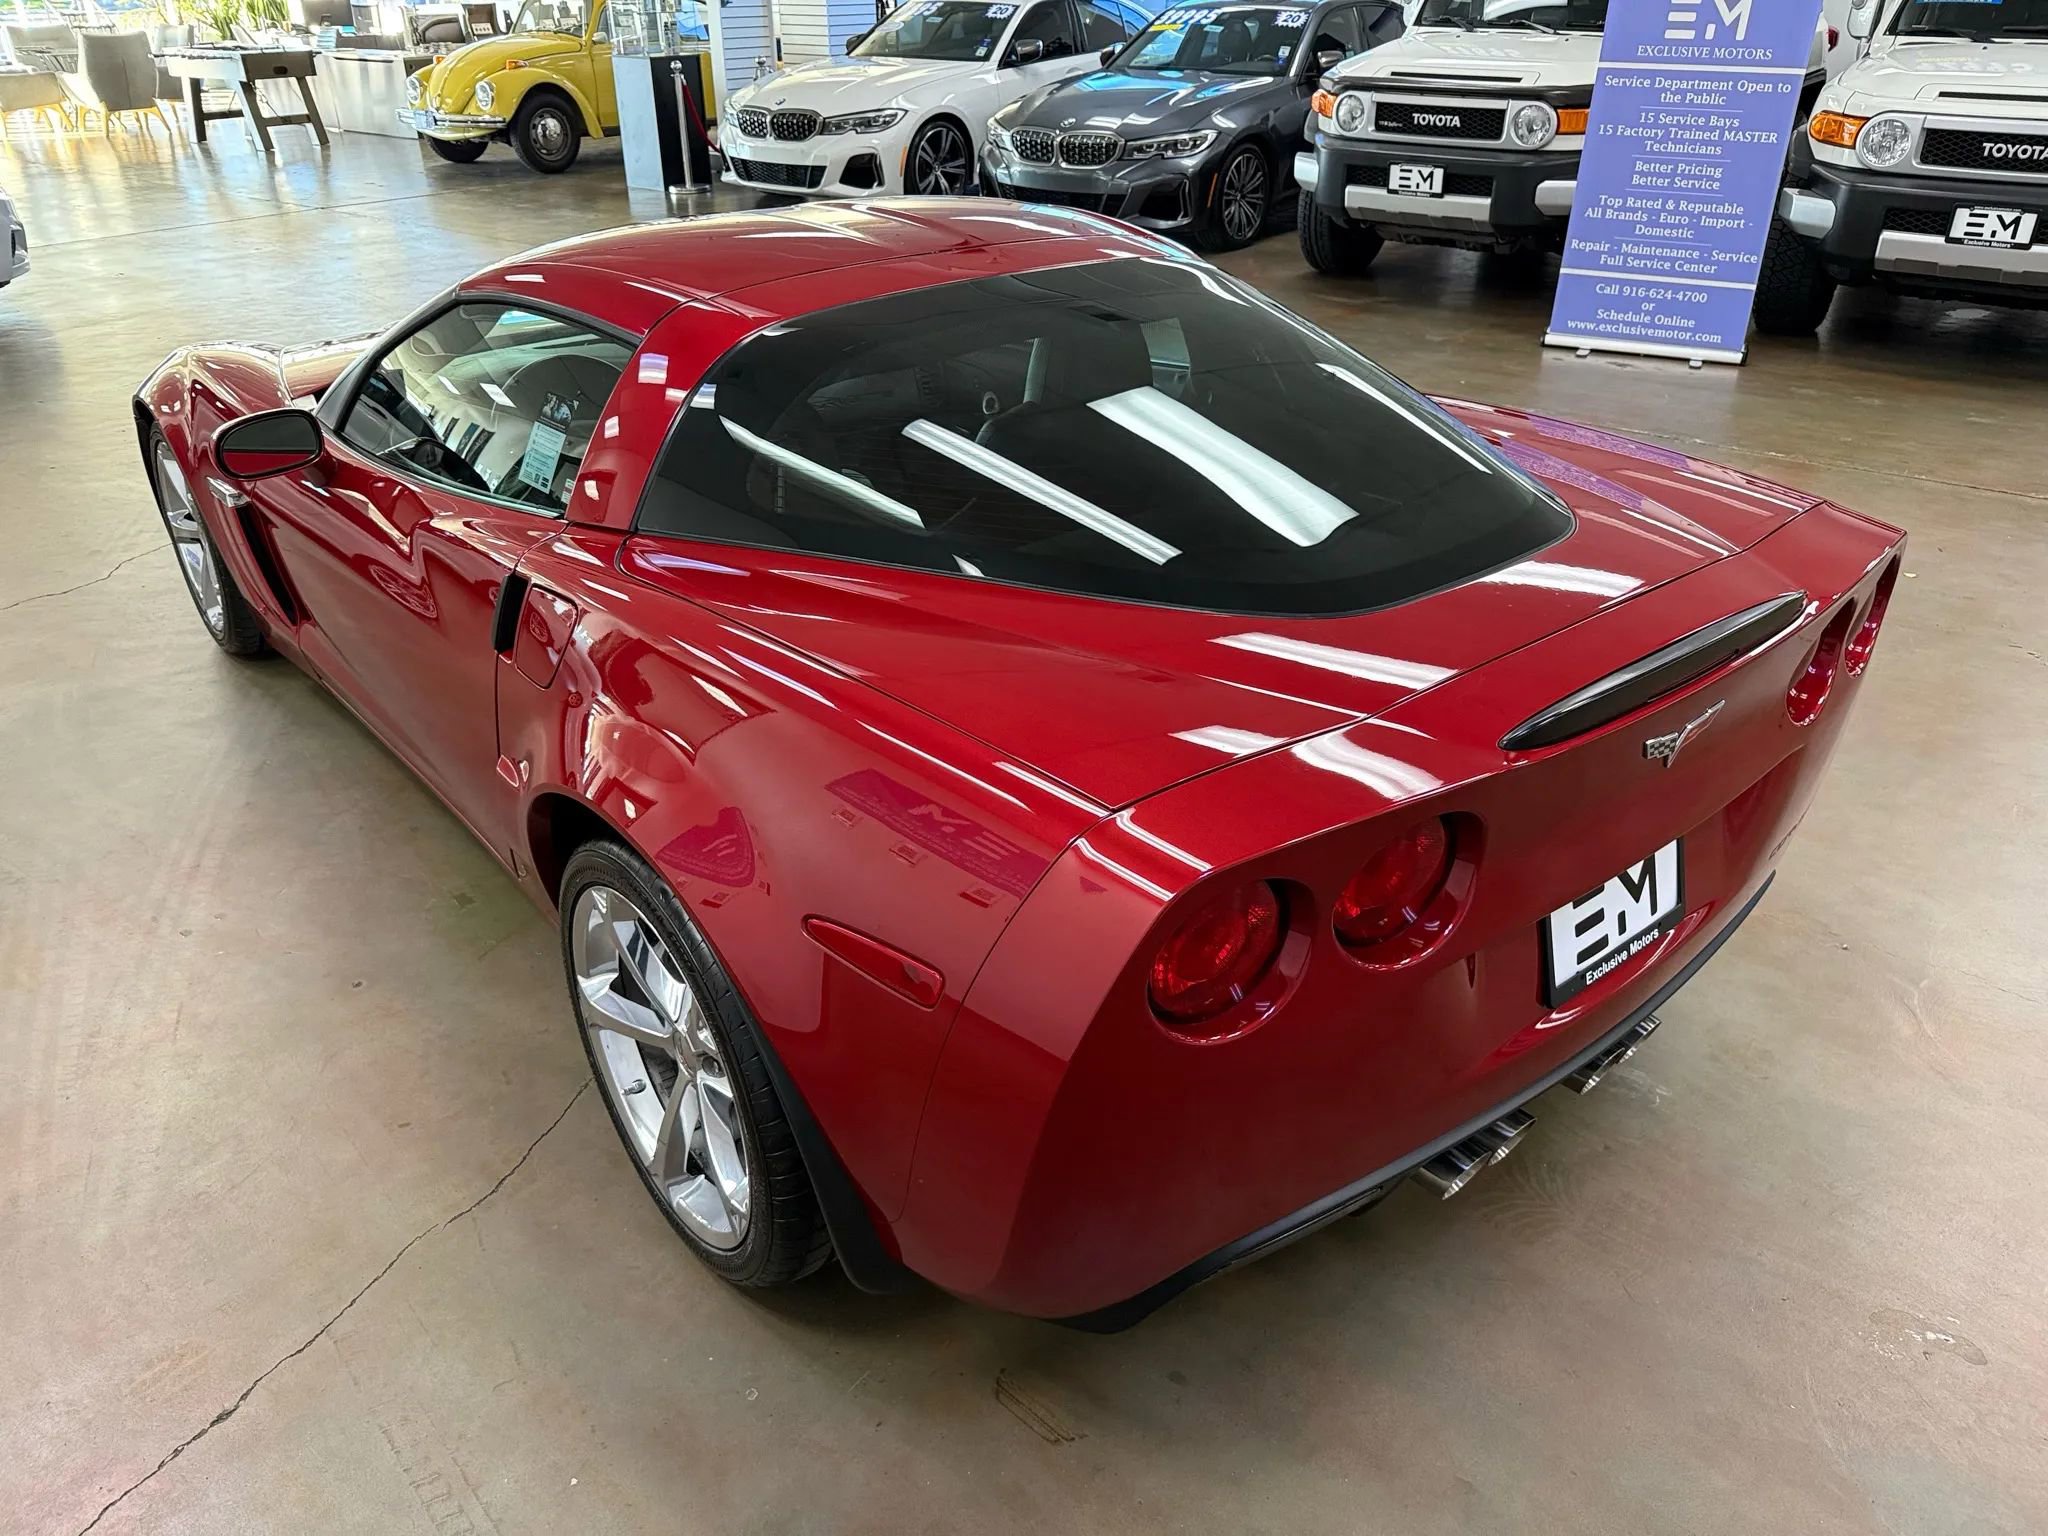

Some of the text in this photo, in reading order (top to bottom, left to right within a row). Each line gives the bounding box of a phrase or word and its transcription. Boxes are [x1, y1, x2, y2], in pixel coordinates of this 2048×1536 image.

[992, 6, 1009, 15] 20
[1282, 14, 1301, 24] 20
[1637, 45, 1773, 60] EXCLUSIVE MOTORS
[1605, 75, 1791, 94] Service Department Open to
[1660, 91, 1726, 105] the Public
[1412, 113, 1461, 127] TOYOTA
[1640, 113, 1740, 128] 15 Service Bays
[1598, 125, 1778, 144] 15 Factory Trained MASTER
[1644, 140, 1722, 155] Technicians
[1635, 161, 1723, 178] Better Pricing
[1398, 168, 1434, 191] EM
[1632, 174, 1720, 190] Better Service
[1599, 195, 1744, 215] Top Rated & Reputable
[1585, 208, 1601, 219] All
[1605, 209, 1648, 222] Brands
[1659, 213, 1689, 225] Euro
[1700, 215, 1745, 231] Import
[1963, 212, 2022, 240] EM
[1635, 224, 1694, 239] Domestic
[1571, 239, 1610, 254] Repair
[1621, 243, 1700, 259] Maintenance
[1711, 250, 1758, 264] Service
[1600, 255, 1717, 274] Full Service Center
[1596, 283, 1708, 303] Call 916-624-4700
[1641, 301, 1655, 311] or
[1596, 308, 1695, 328] Schedule Online
[1567, 319, 1722, 343] www.exclusivemotor.com
[1585, 928, 1659, 986] Exclusive Motors
